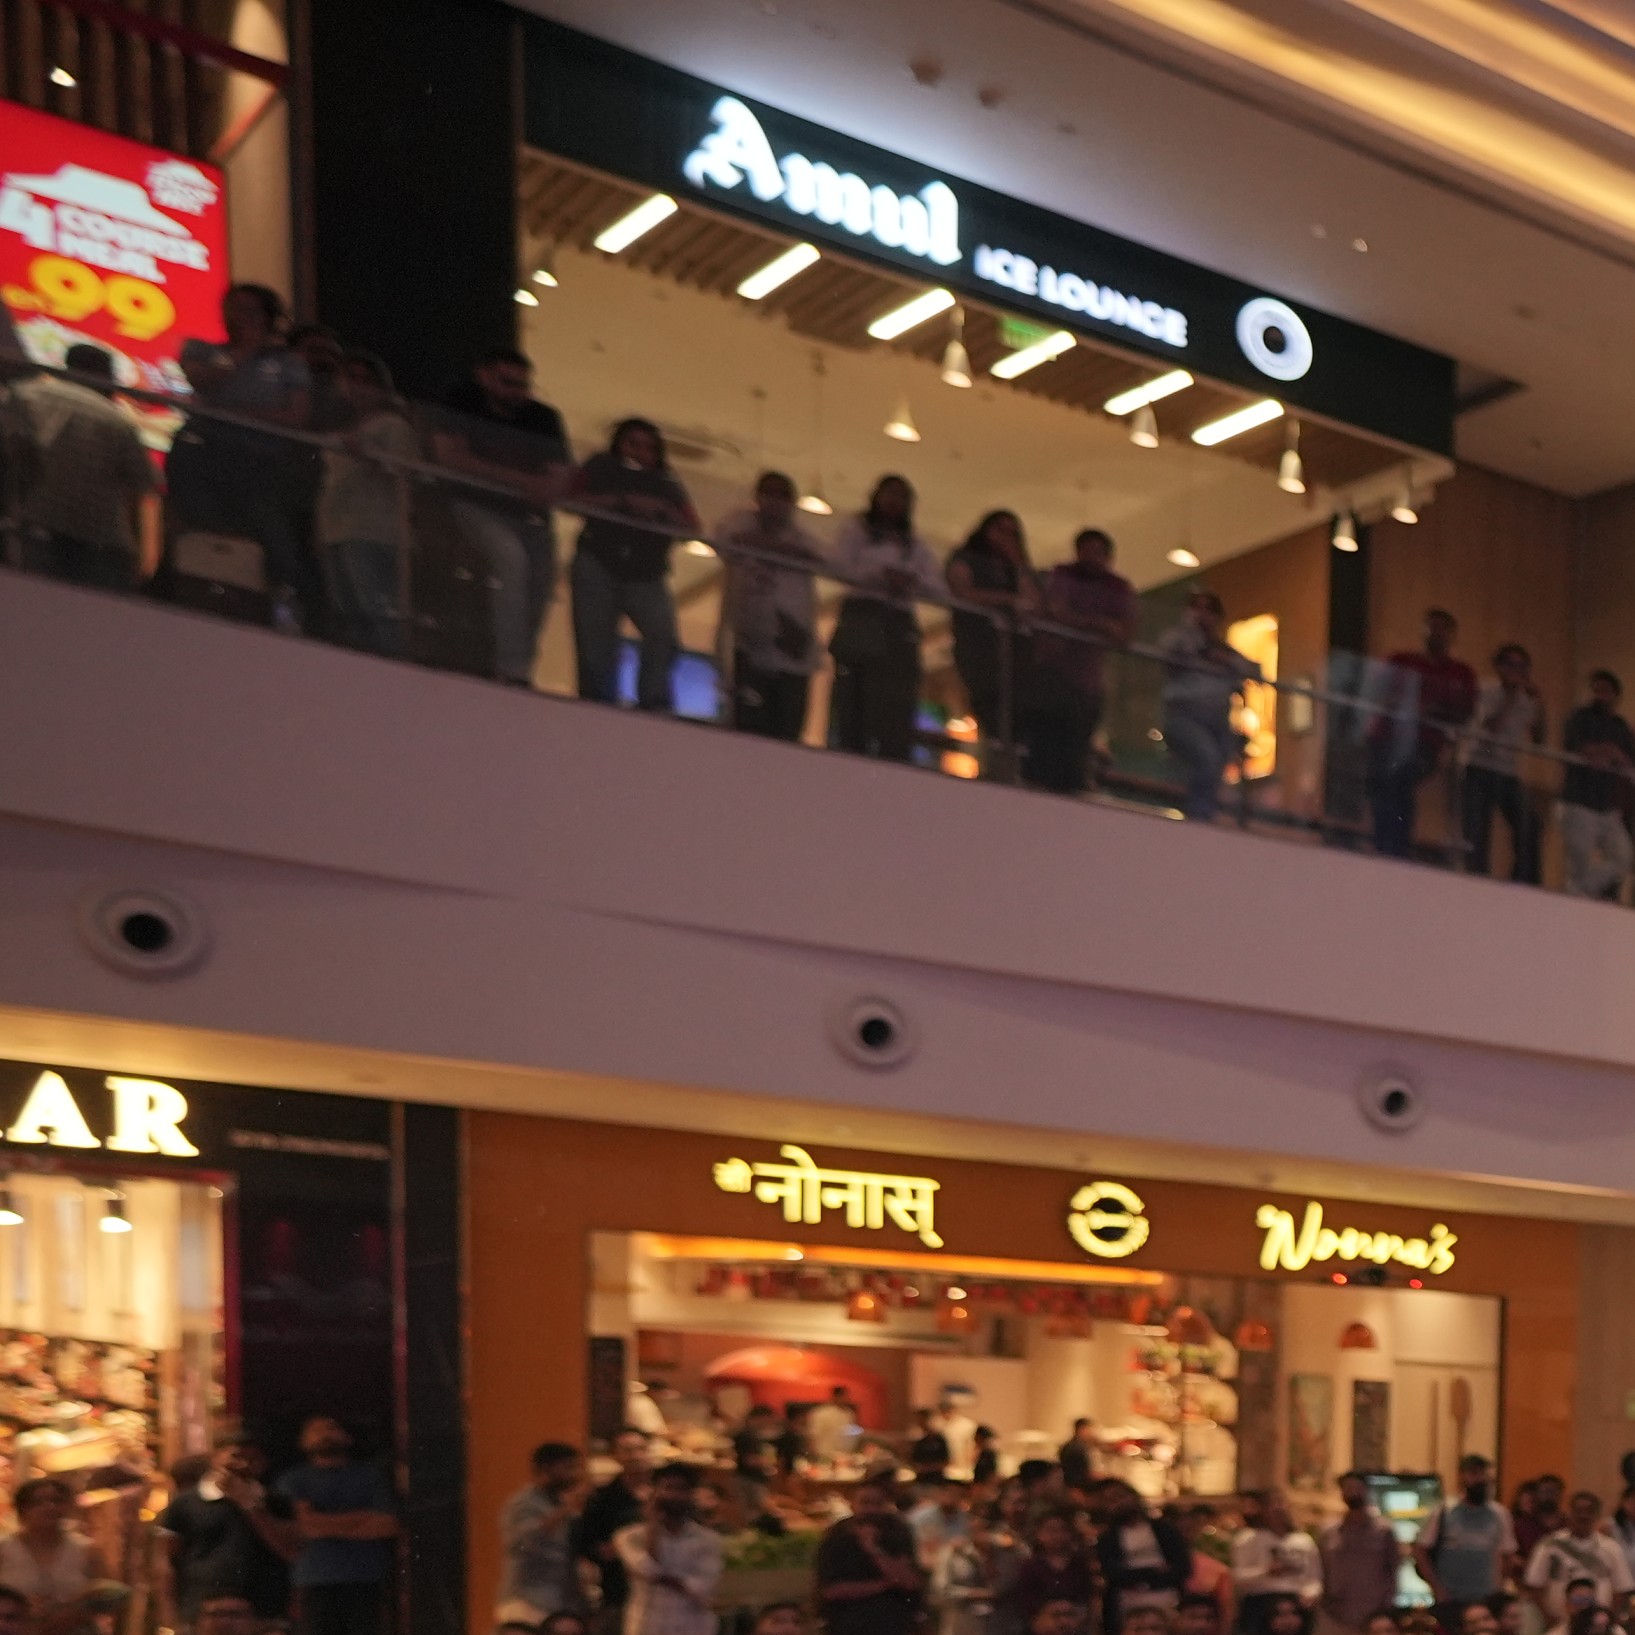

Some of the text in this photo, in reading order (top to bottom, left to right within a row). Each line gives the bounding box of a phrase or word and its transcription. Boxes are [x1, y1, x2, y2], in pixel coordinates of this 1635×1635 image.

[54, 203, 210, 272] COURSE
[683, 95, 962, 265] Amul
[973, 243, 1038, 296] ICE
[1038, 263, 1189, 348] LOUNGE
[0, 1070, 200, 1157] AR
[1255, 1200, 1459, 1275] Nonna's
